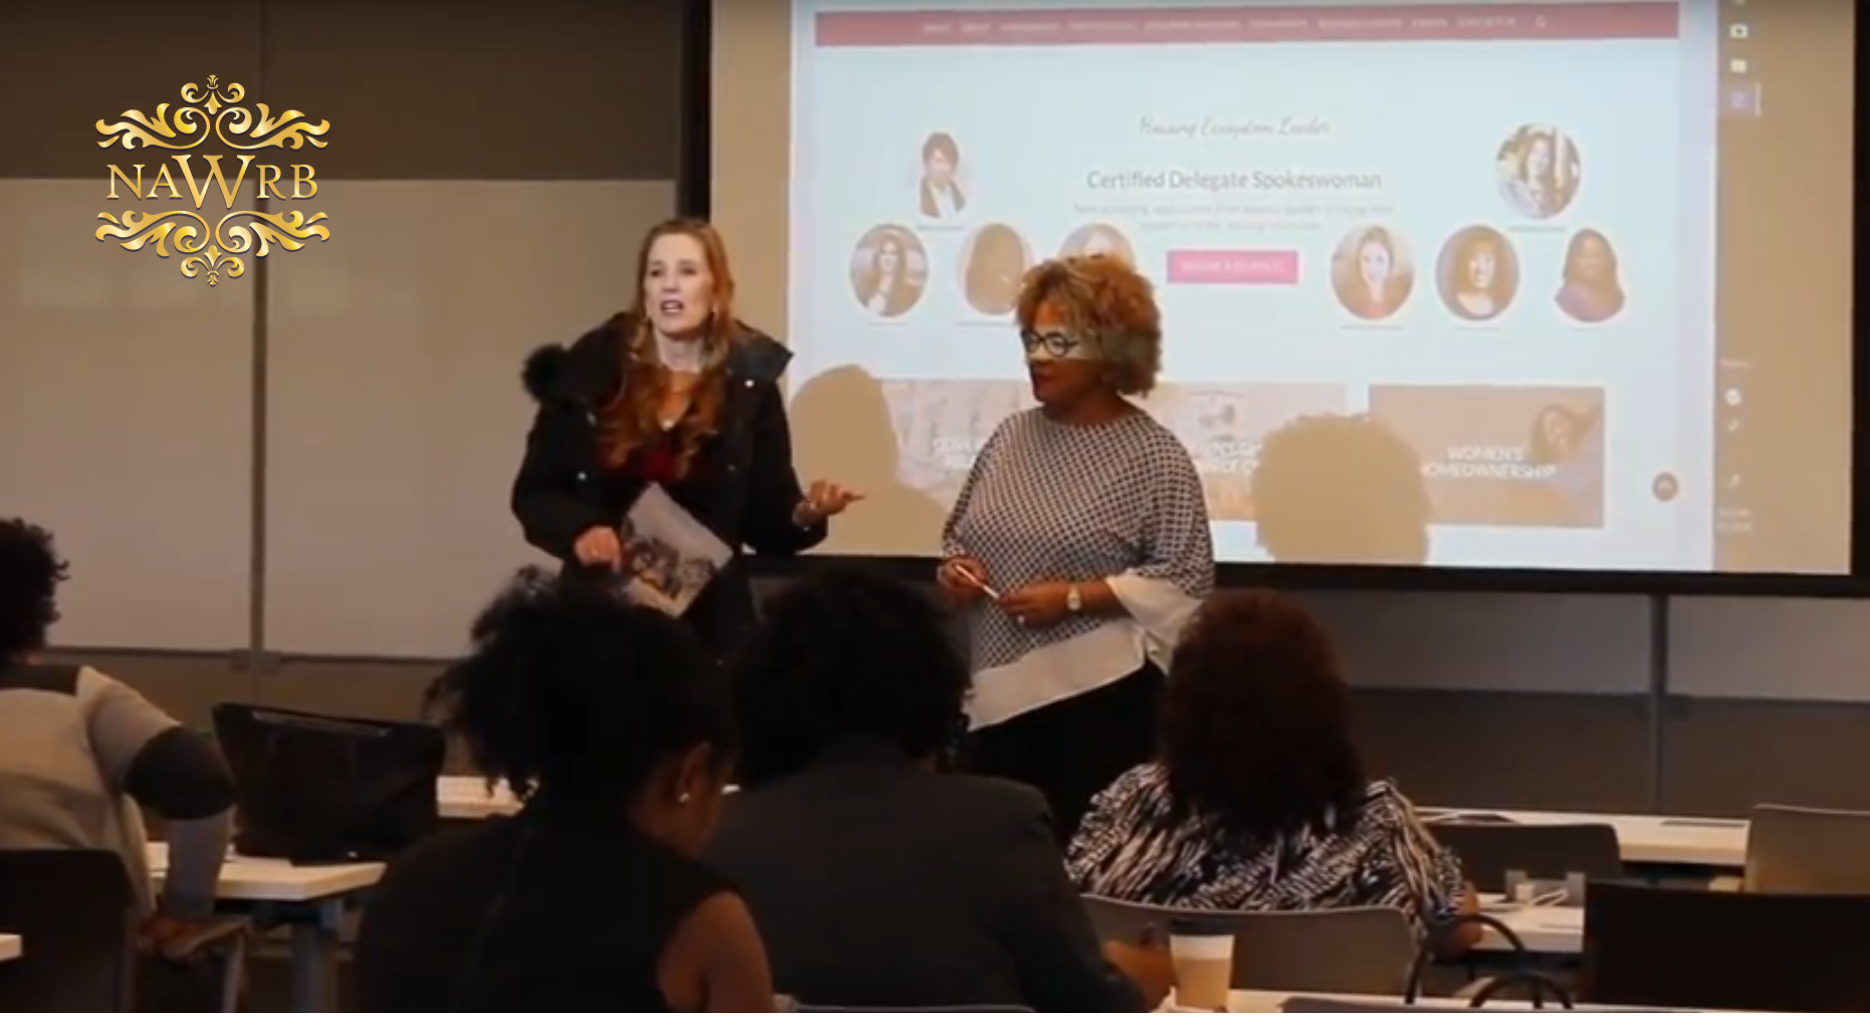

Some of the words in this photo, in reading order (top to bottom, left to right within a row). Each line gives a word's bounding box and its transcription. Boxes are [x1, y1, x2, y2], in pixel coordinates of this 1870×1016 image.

[1086, 170, 1165, 190] Certified
[1169, 170, 1248, 191] Delegate
[1252, 170, 1382, 191] Spokeswoman
